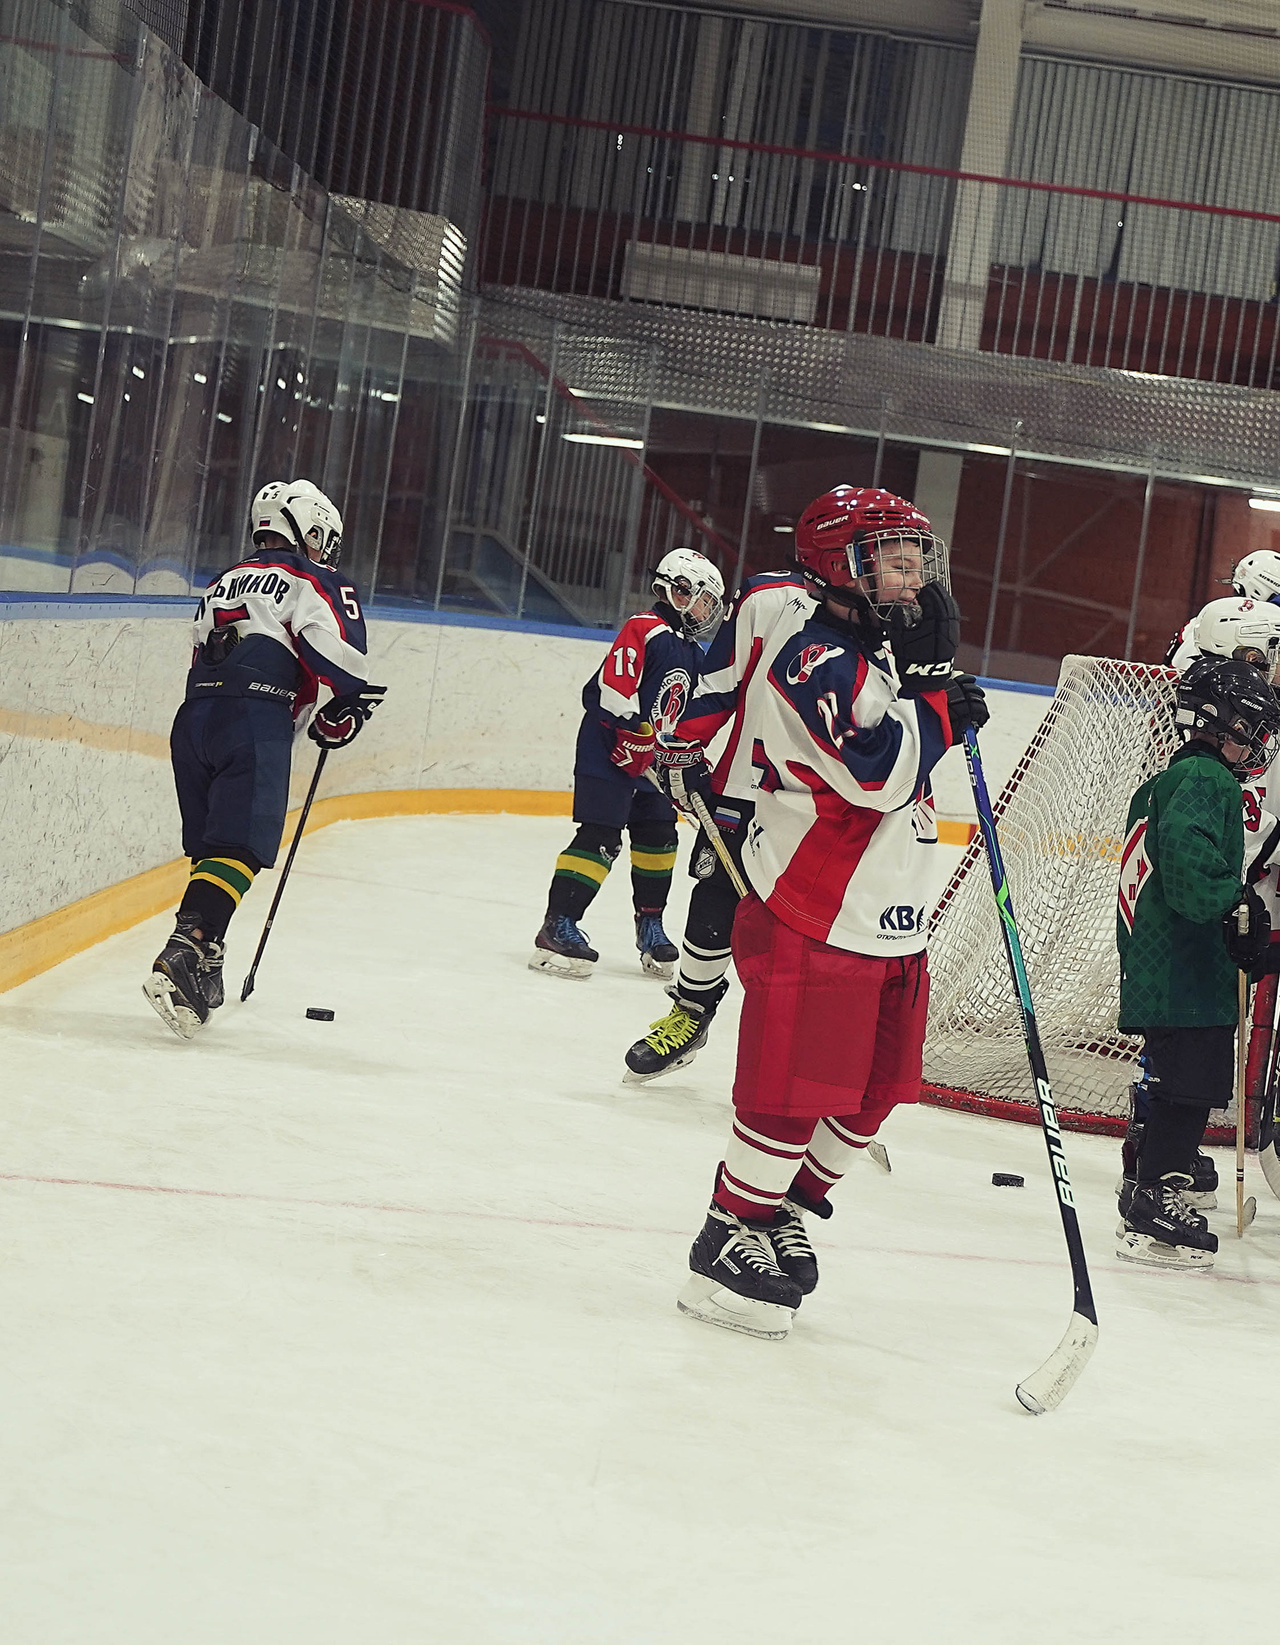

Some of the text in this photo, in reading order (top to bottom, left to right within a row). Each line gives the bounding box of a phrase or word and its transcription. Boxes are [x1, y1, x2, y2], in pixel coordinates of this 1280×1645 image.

[816, 514, 849, 531] BAUER
[195, 573, 290, 621] ЬНИКОВ
[339, 586, 360, 620] 5
[905, 657, 954, 676] CM
[248, 682, 297, 700] BAUER
[653, 750, 702, 765] AUER
[1037, 1077, 1075, 1208] BAUER
